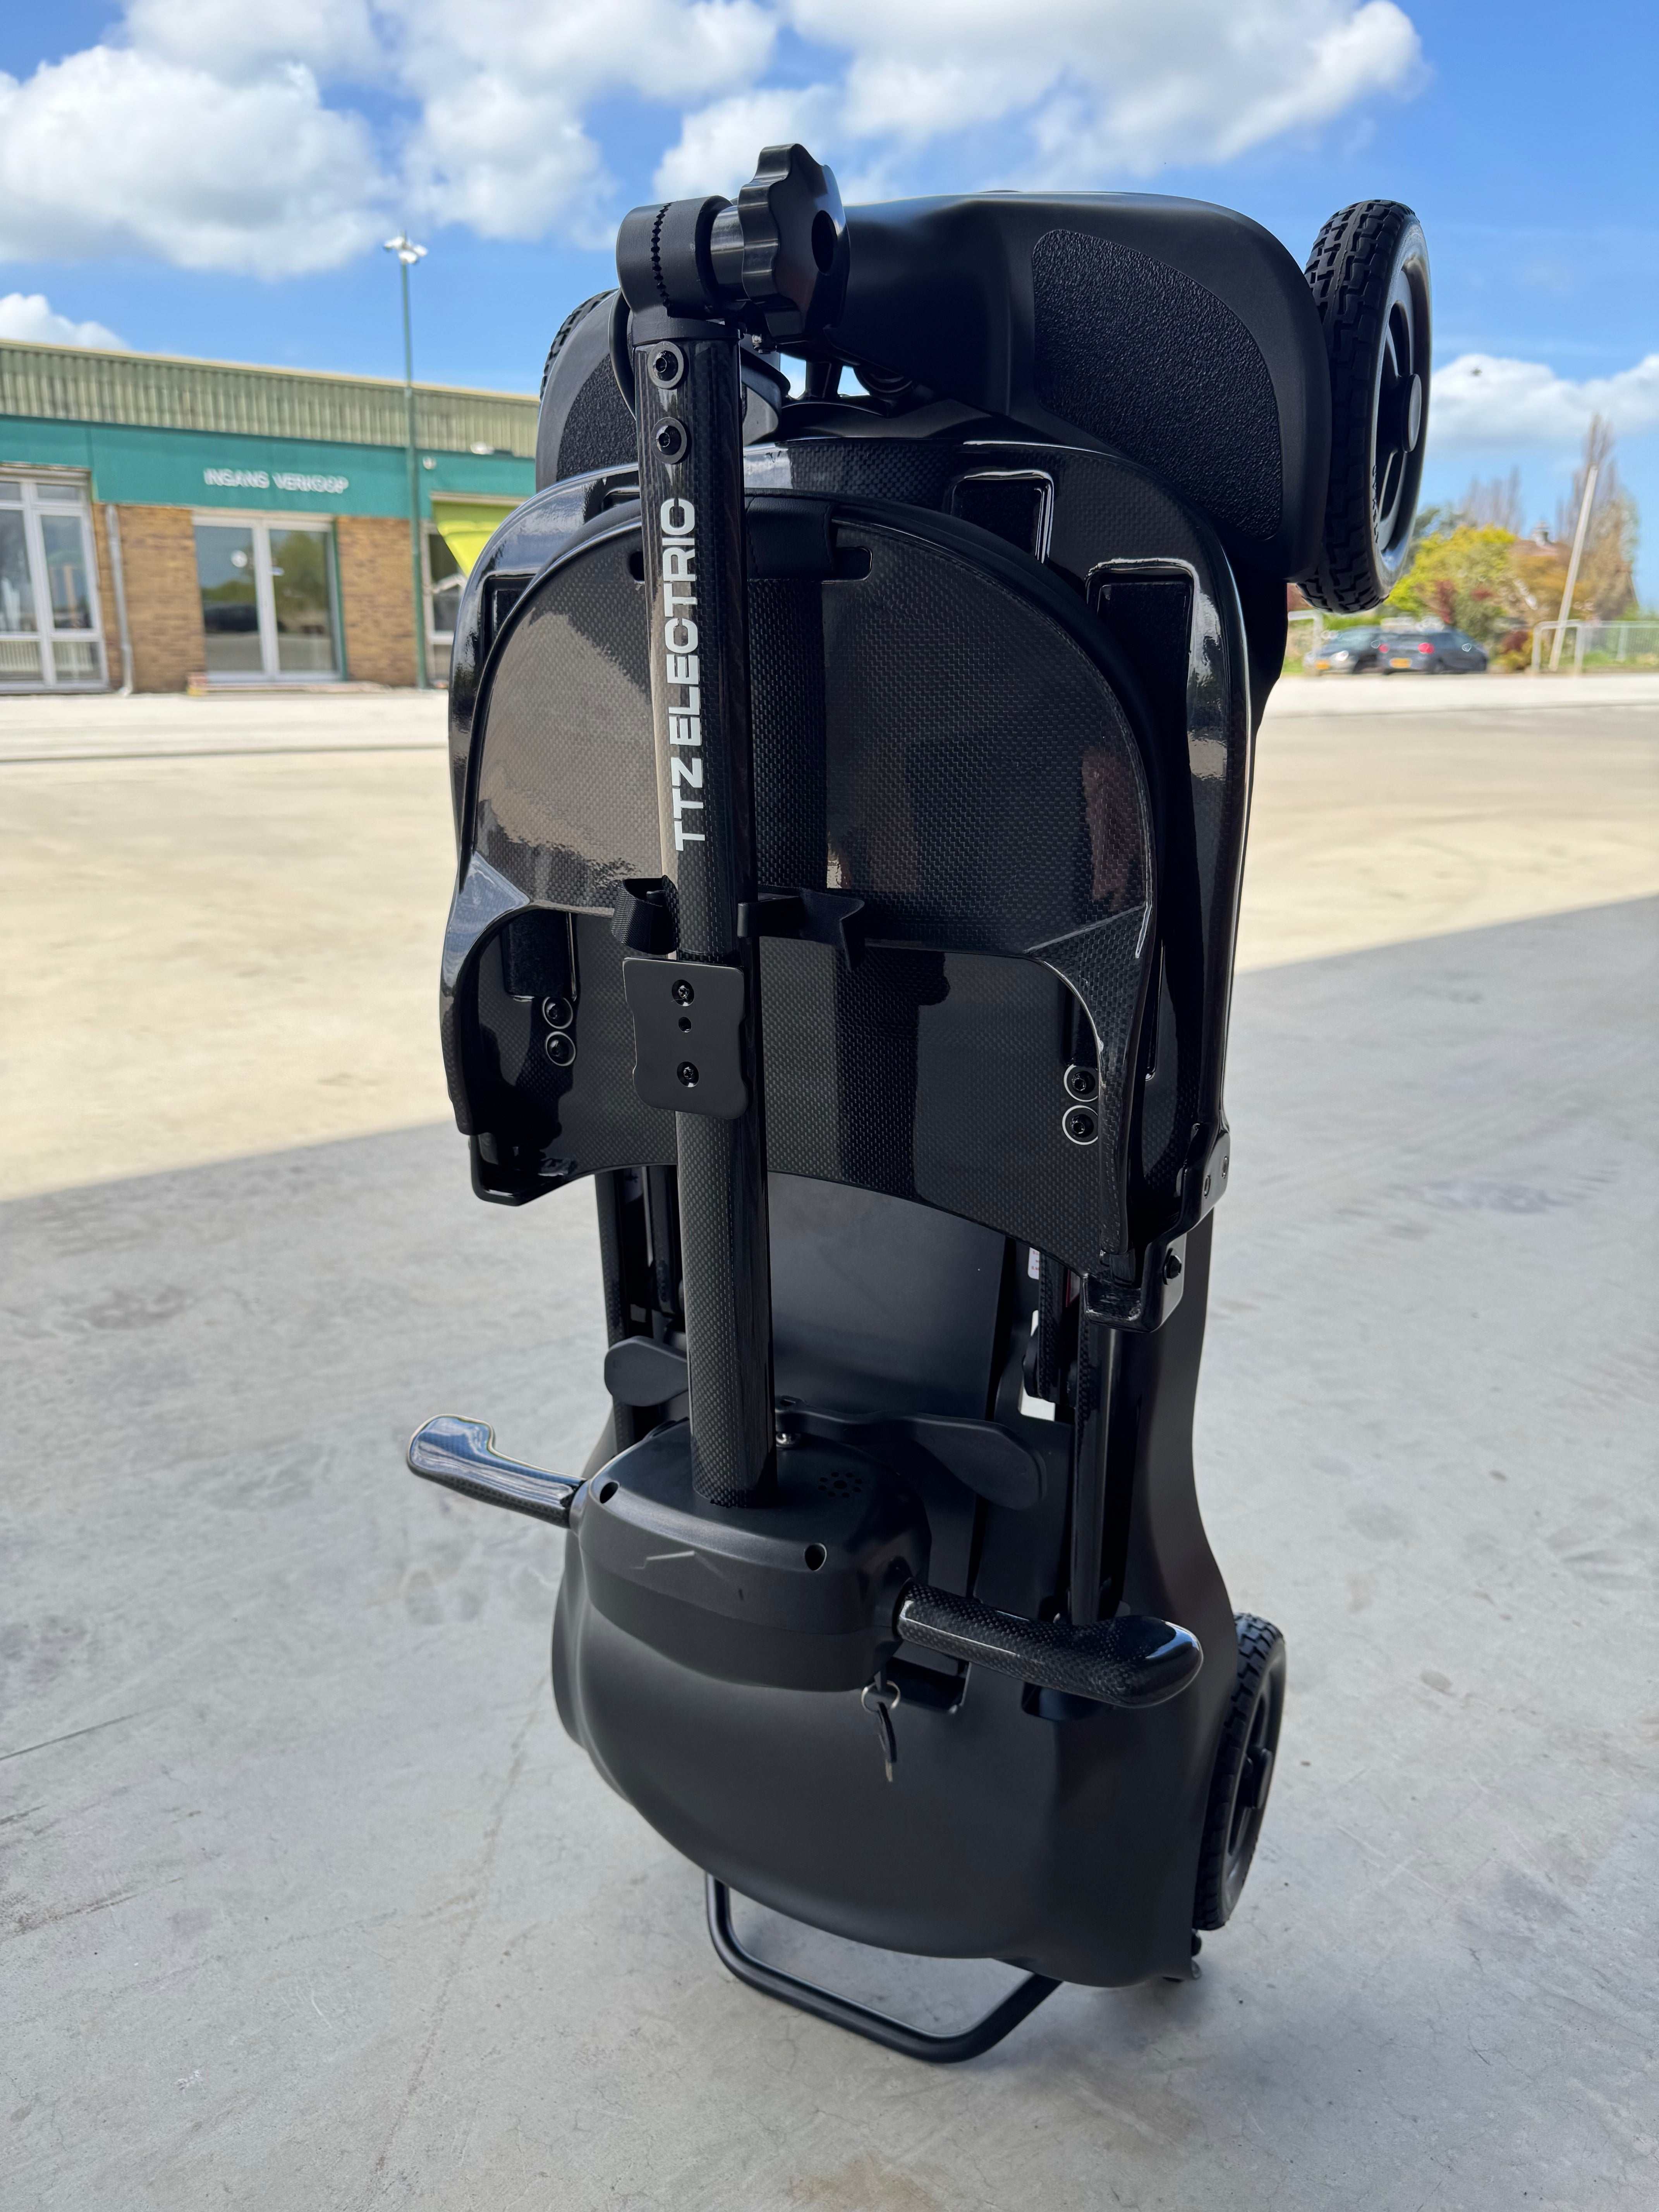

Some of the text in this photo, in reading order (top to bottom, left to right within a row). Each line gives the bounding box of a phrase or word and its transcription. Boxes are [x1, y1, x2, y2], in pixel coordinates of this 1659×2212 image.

[272, 472, 349, 494] VERKOOP
[661, 498, 705, 851] TTZ ELECTRIC
